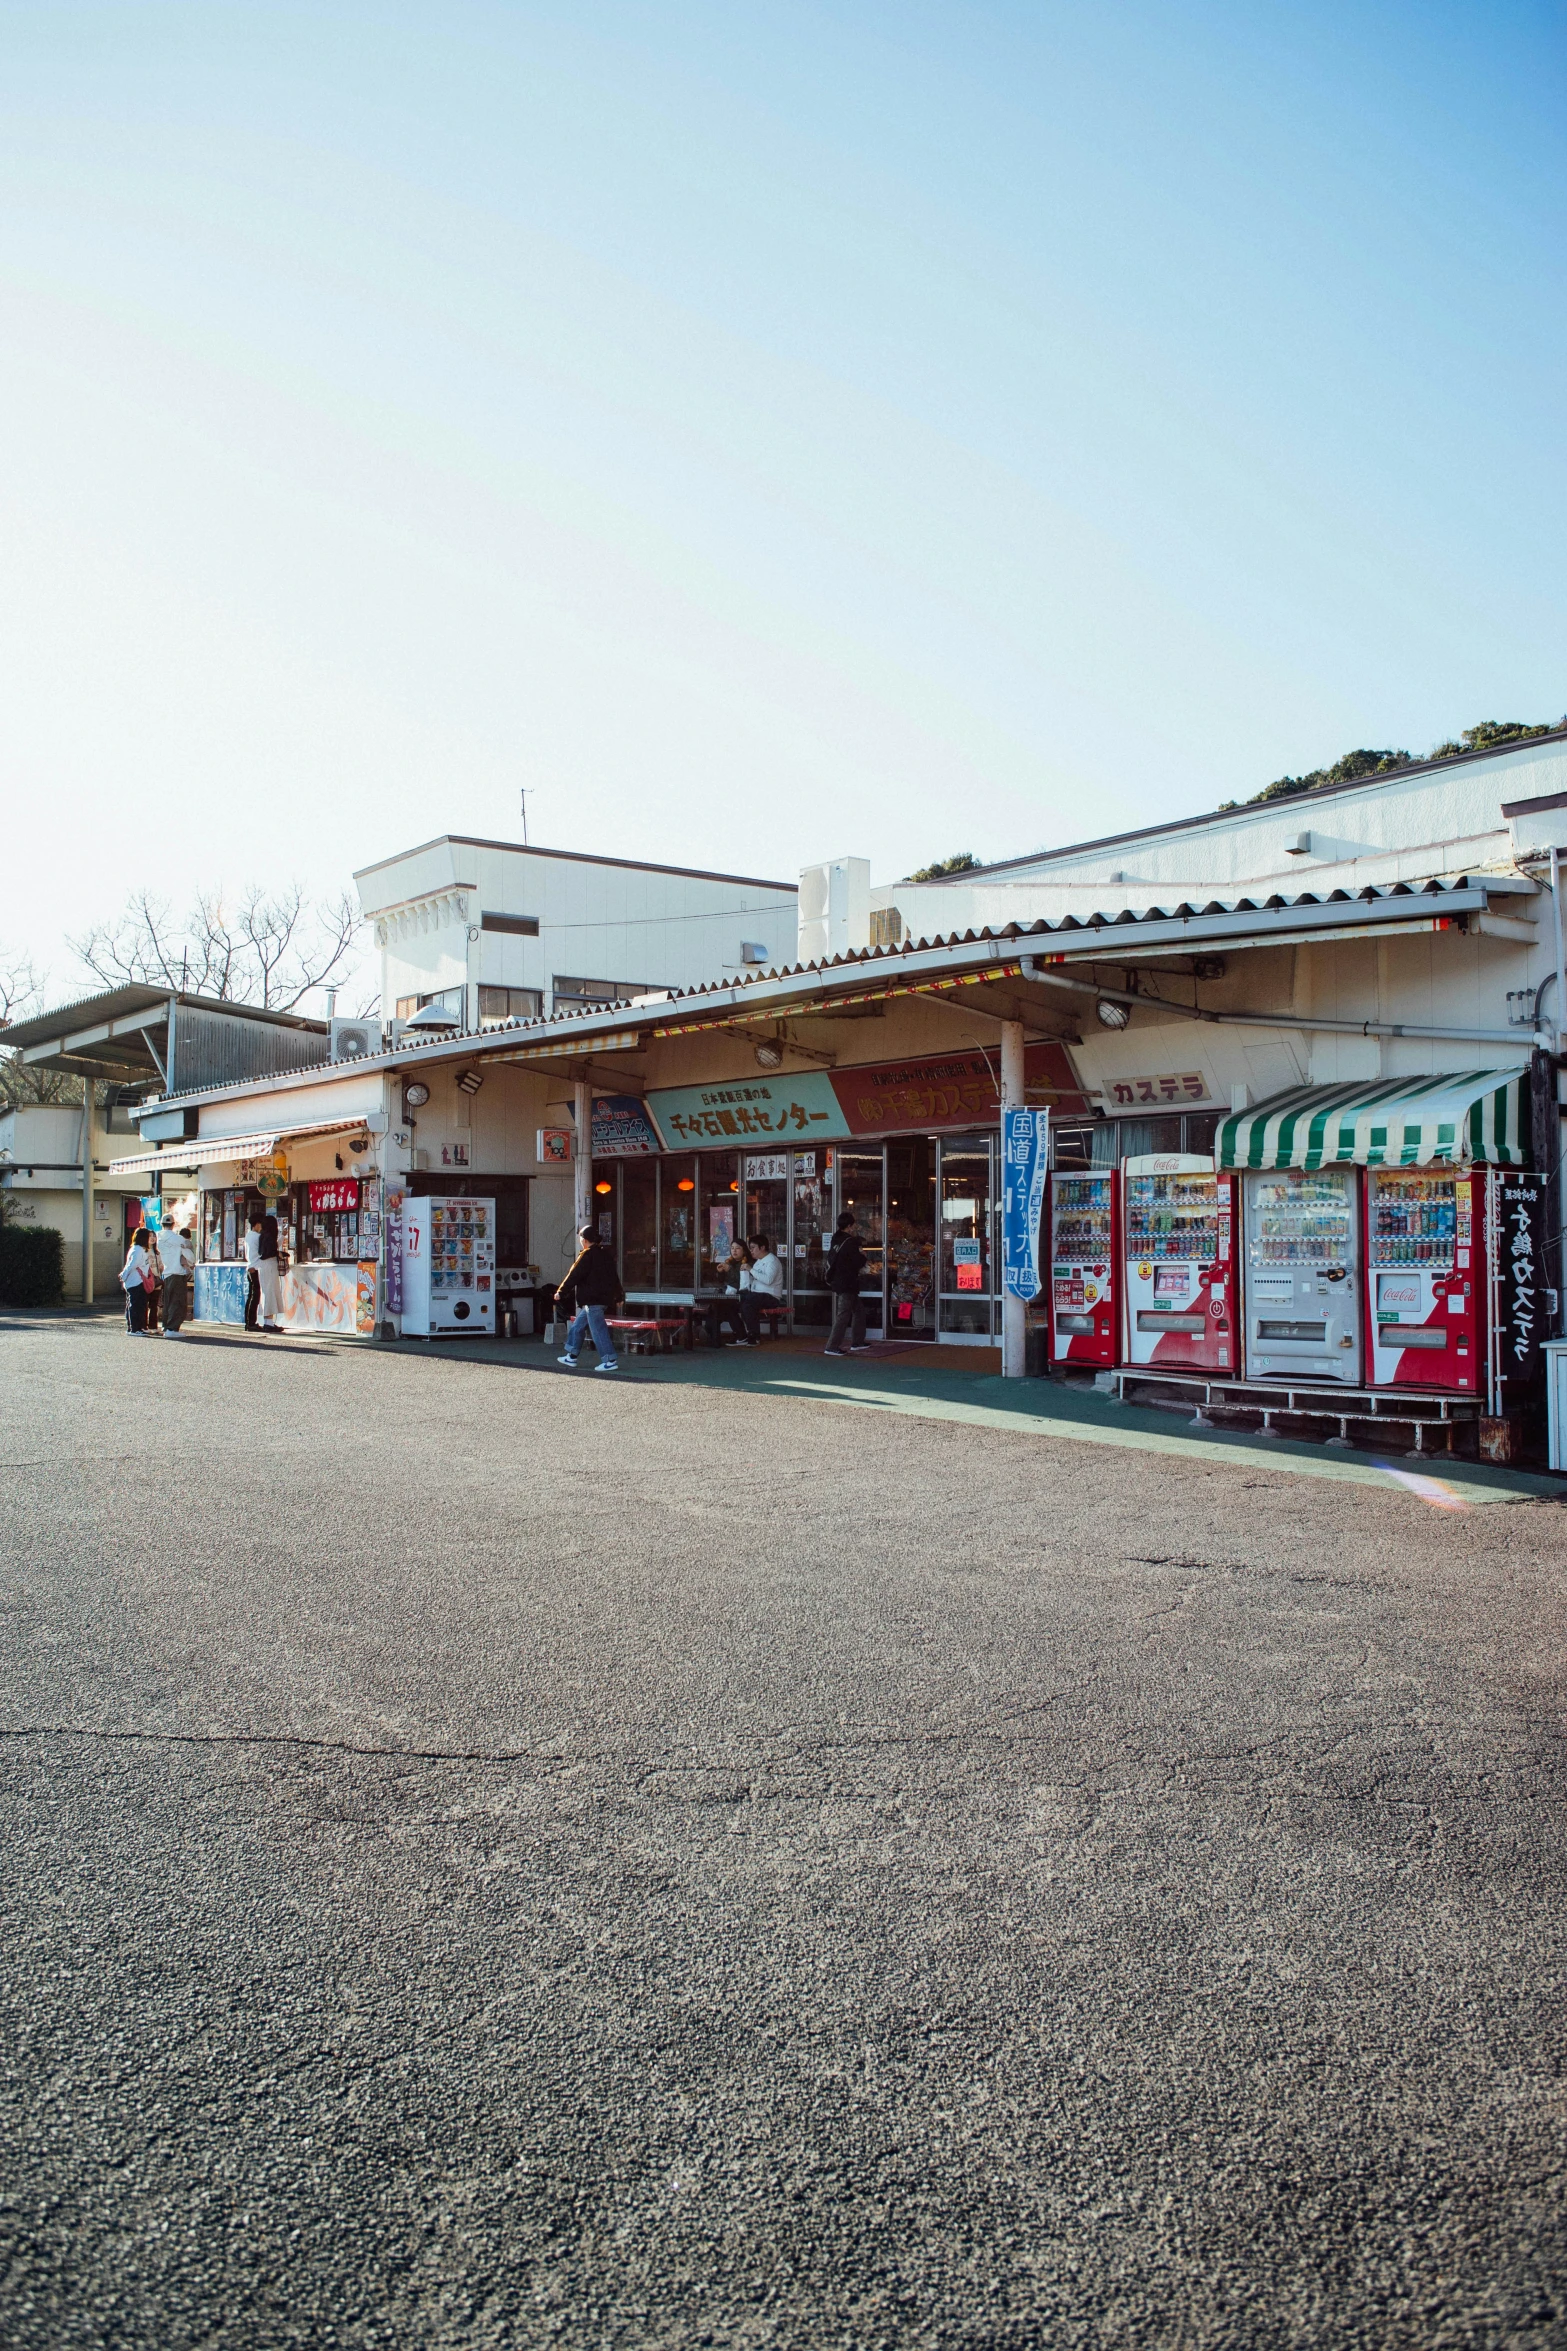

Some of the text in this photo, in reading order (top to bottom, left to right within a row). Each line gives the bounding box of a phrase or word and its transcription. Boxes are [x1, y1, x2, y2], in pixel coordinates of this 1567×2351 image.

[1113, 1076, 1204, 1104] カステラ
[592, 1118, 650, 1139] ルーシールアイス
[747, 1159, 786, 1178] お食事処
